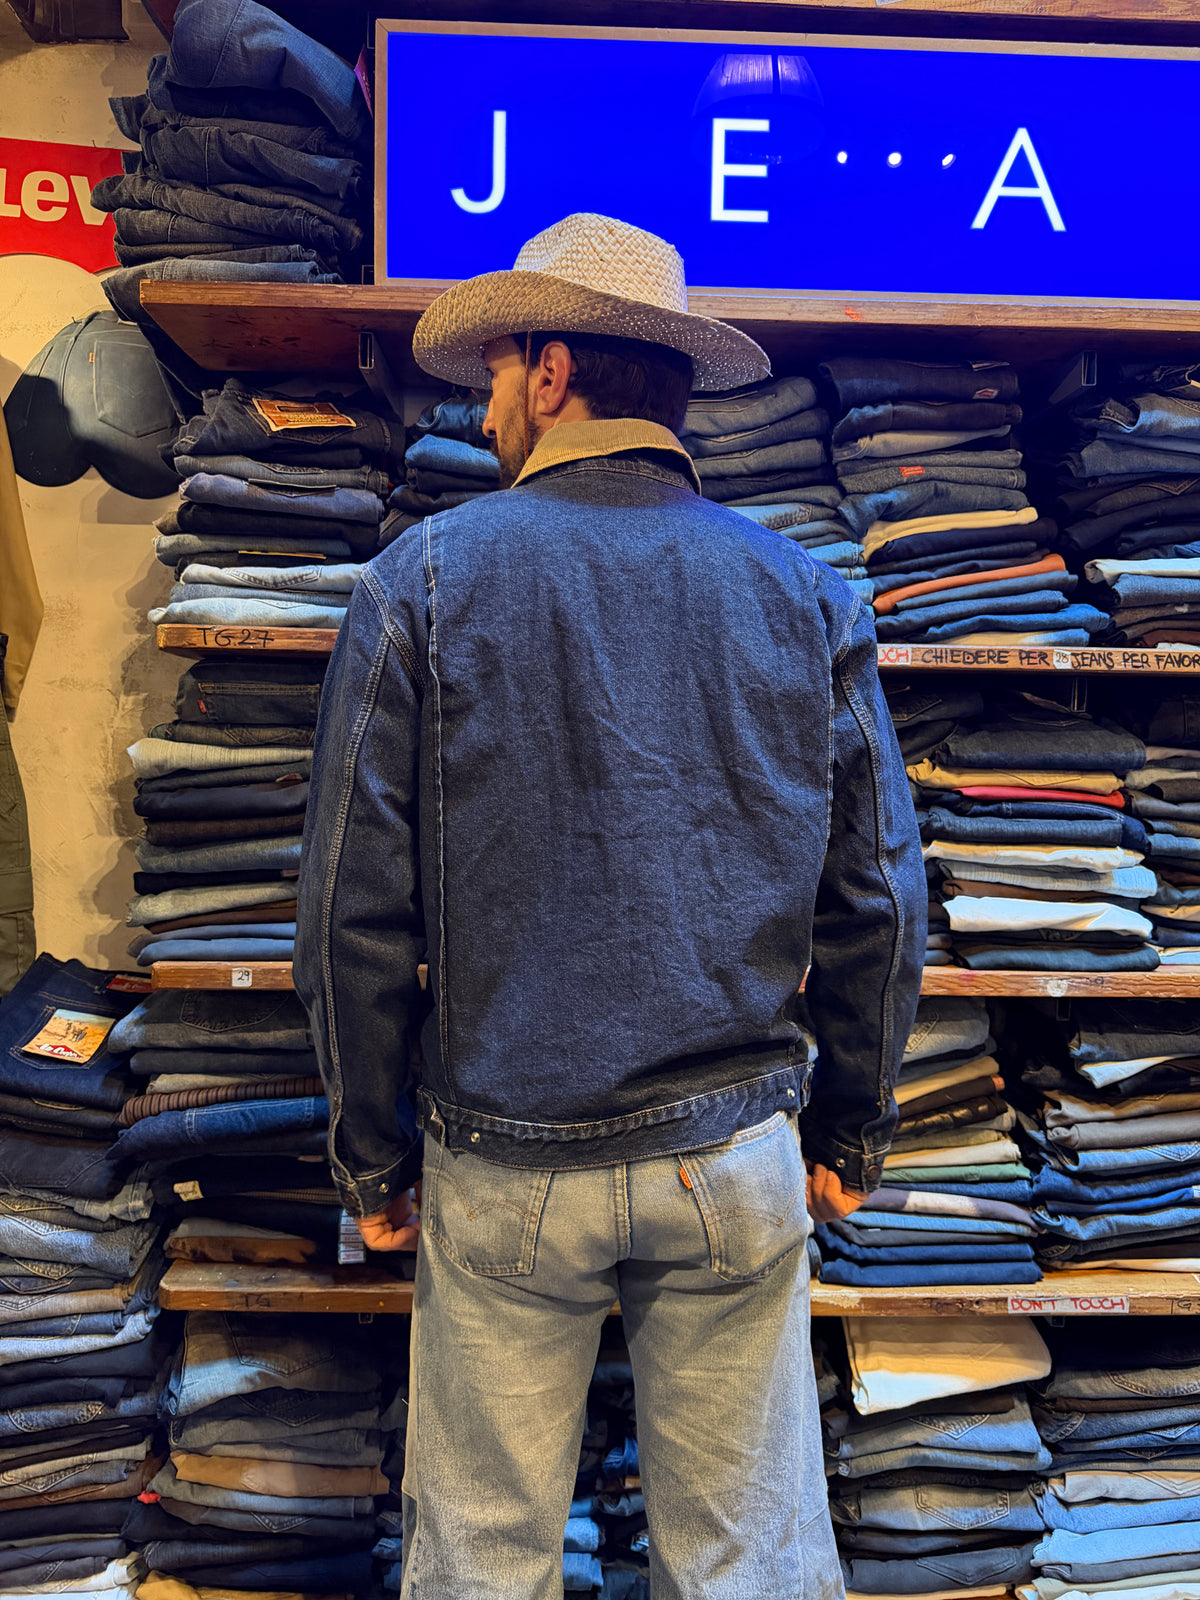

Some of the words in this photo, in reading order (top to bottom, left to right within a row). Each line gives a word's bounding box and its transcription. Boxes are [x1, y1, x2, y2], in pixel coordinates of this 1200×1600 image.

[921, 648, 1011, 665] CHIEDERE
[1018, 649, 1051, 666] PER
[1070, 652, 1115, 670] JEANS
[1122, 652, 1151, 669] PER
[237, 970, 250, 981] 29
[1010, 1297, 1058, 1311] DON'T
[1070, 1298, 1125, 1311] TOUCH
